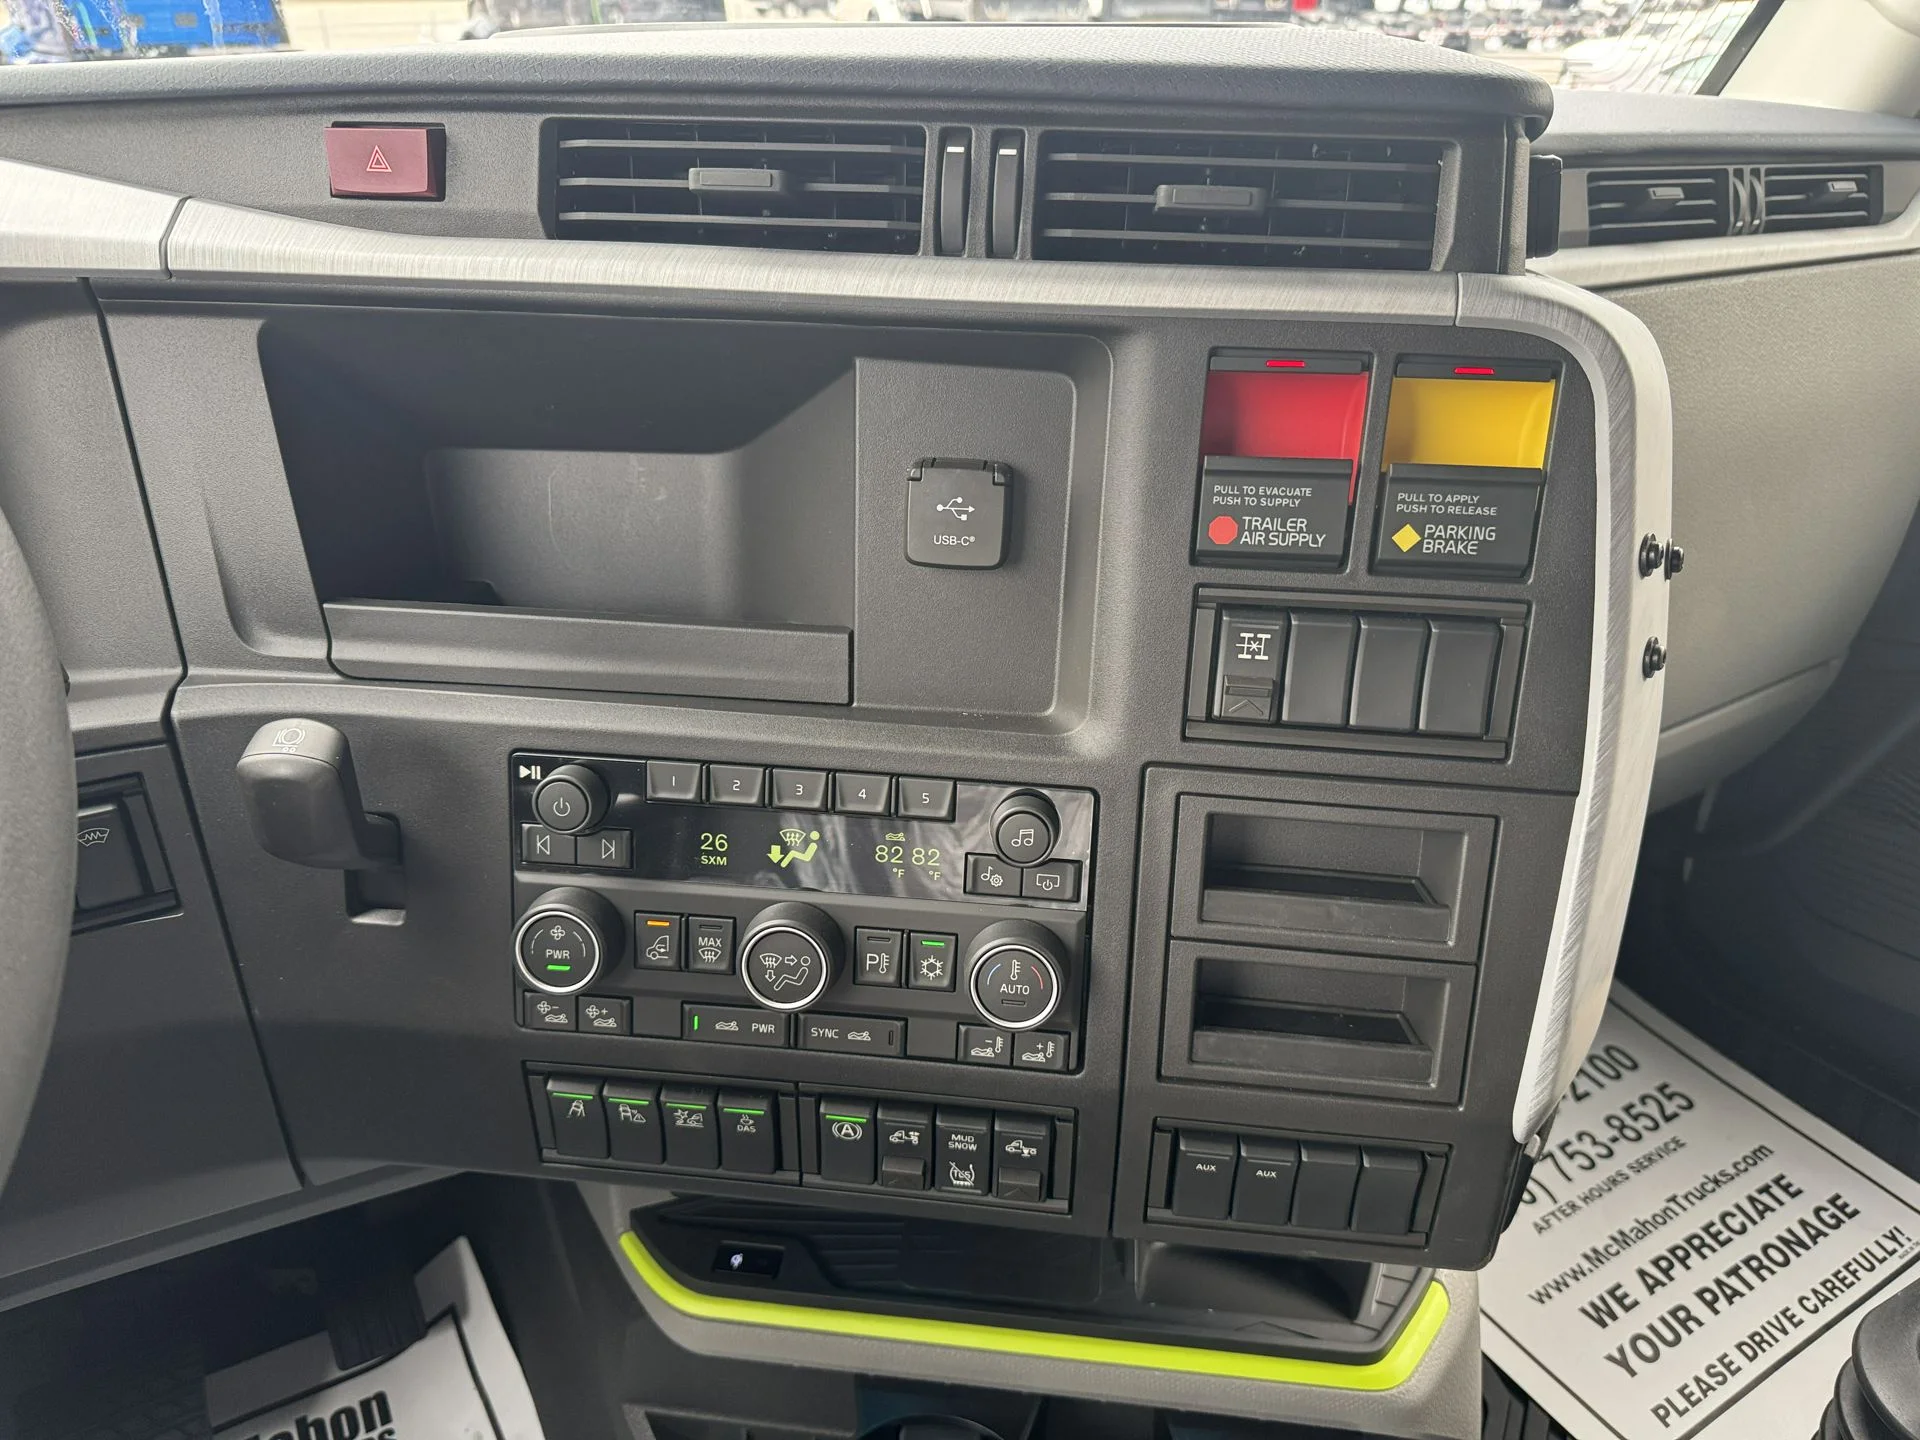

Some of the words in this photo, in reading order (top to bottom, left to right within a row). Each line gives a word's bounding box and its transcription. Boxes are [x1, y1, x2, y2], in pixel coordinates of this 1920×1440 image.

[1213, 485, 1240, 494] PULL
[1242, 486, 1256, 495] TO
[1258, 486, 1313, 497] EVACUATE
[1212, 496, 1241, 505] PUSH
[1244, 497, 1258, 506] TO
[1260, 497, 1301, 507] SUPPLY
[1397, 492, 1425, 502] PULL
[1428, 493, 1443, 503] TO
[1444, 494, 1480, 504] APPLY
[1396, 503, 1428, 513] PUSH
[1430, 504, 1445, 514] TO
[1447, 505, 1498, 516] RELEASE
[1242, 516, 1308, 533] TRAILER
[1424, 524, 1497, 541] PARKING
[1240, 531, 1266, 546] AIR
[1268, 531, 1327, 548] SUPPLY
[1422, 539, 1479, 555] BRAKE
[732, 779, 742, 792] 2
[795, 784, 805, 796] 3
[858, 788, 867, 800] 4
[922, 792, 931, 805] 5
[700, 832, 728, 851] 26
[700, 855, 728, 866] SXM
[874, 844, 904, 864] 82
[911, 847, 941, 867] 82
[698, 937, 722, 947] MAX
[546, 949, 571, 960] PWR
[1000, 983, 1031, 996] AUTO
[751, 1023, 776, 1034] PWR
[811, 1026, 840, 1039] SYNC
[737, 1124, 757, 1133] DAS
[951, 1133, 975, 1143] MUD
[948, 1141, 978, 1152] SNOW
[1195, 1162, 1217, 1172] AUX
[1256, 1169, 1277, 1179] AUX
[1532, 1198, 1580, 1237] AFTER
[1577, 1168, 1631, 1209] HOURS
[1626, 1135, 1688, 1174] SERVICE
[1528, 1143, 1776, 1307] www.McMahonTrucks.com
[1578, 1281, 1641, 1331] WE
[1635, 1172, 1805, 1297] APPRECIATE
[1603, 1304, 1706, 1380] YOUR
[1693, 1192, 1862, 1316] PATRONAGE
[1649, 1351, 1743, 1429] PLEASE
[1741, 1307, 1806, 1363] DRIVE
[1798, 1224, 1913, 1316] CAREFULLY!
